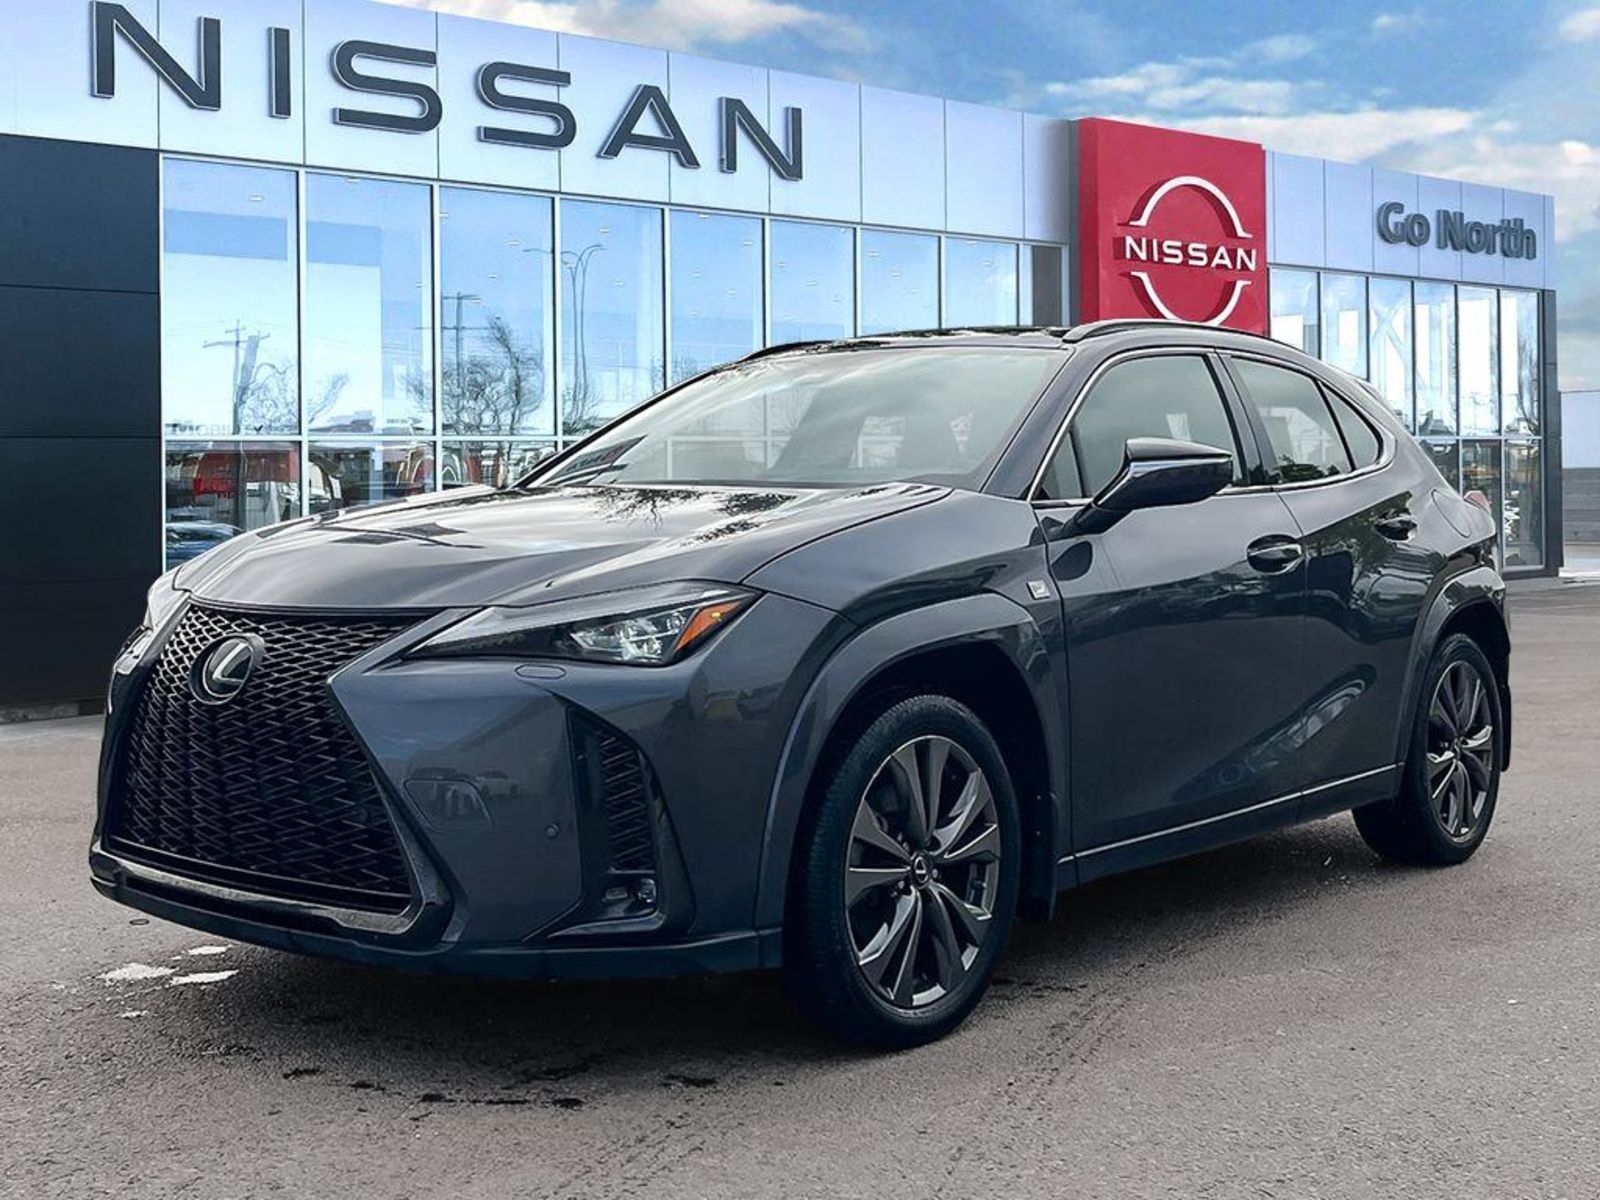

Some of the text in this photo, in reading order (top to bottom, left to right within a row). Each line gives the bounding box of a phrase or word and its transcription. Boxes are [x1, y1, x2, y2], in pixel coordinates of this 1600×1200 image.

[90, 1, 803, 181] NISSAN
[1124, 235, 1257, 271] NISSAN
[1377, 202, 1537, 260] Go North
